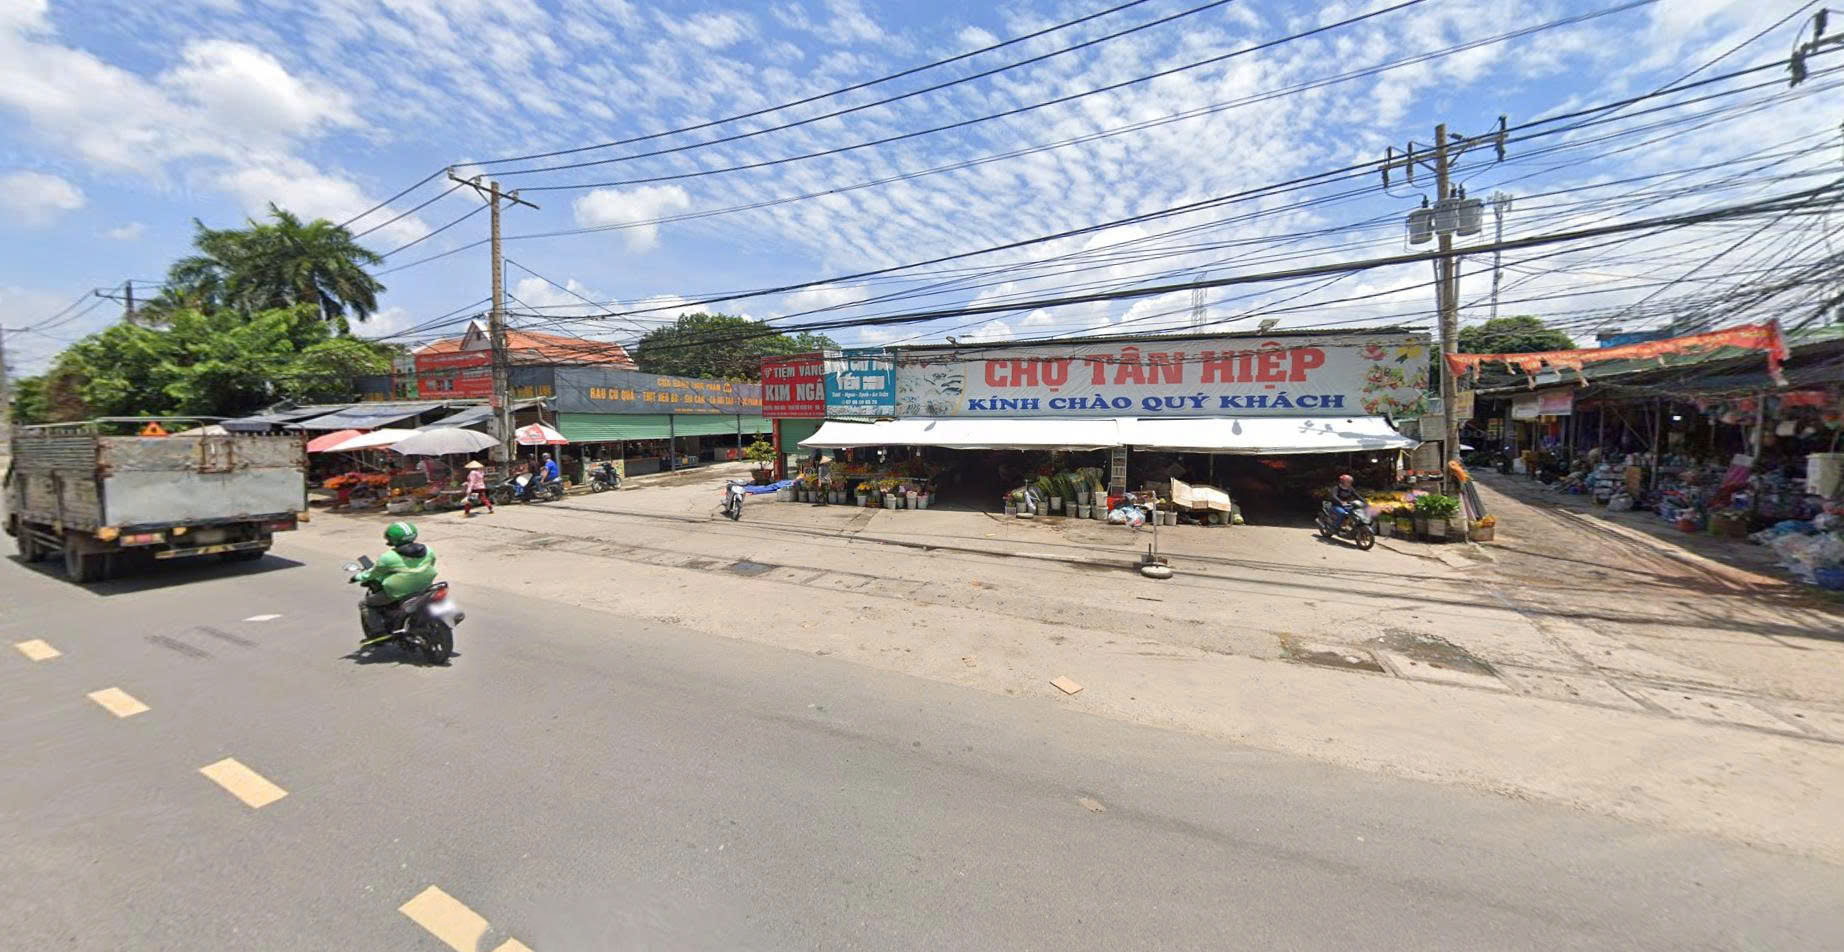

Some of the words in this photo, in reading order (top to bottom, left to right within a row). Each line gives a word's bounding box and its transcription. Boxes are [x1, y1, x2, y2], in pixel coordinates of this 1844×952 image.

[775, 364, 795, 382] TIỆM
[984, 358, 1074, 393] CHỢ
[1087, 345, 1183, 385] TÂN
[1199, 341, 1327, 392] HIỆP
[590, 387, 607, 400] RAU
[766, 384, 791, 401] KIM
[969, 395, 1041, 412] KÍNH
[1048, 395, 1134, 412] CHÀO
[1141, 392, 1210, 413] QUÝ
[1219, 391, 1345, 411] KHÁCH
